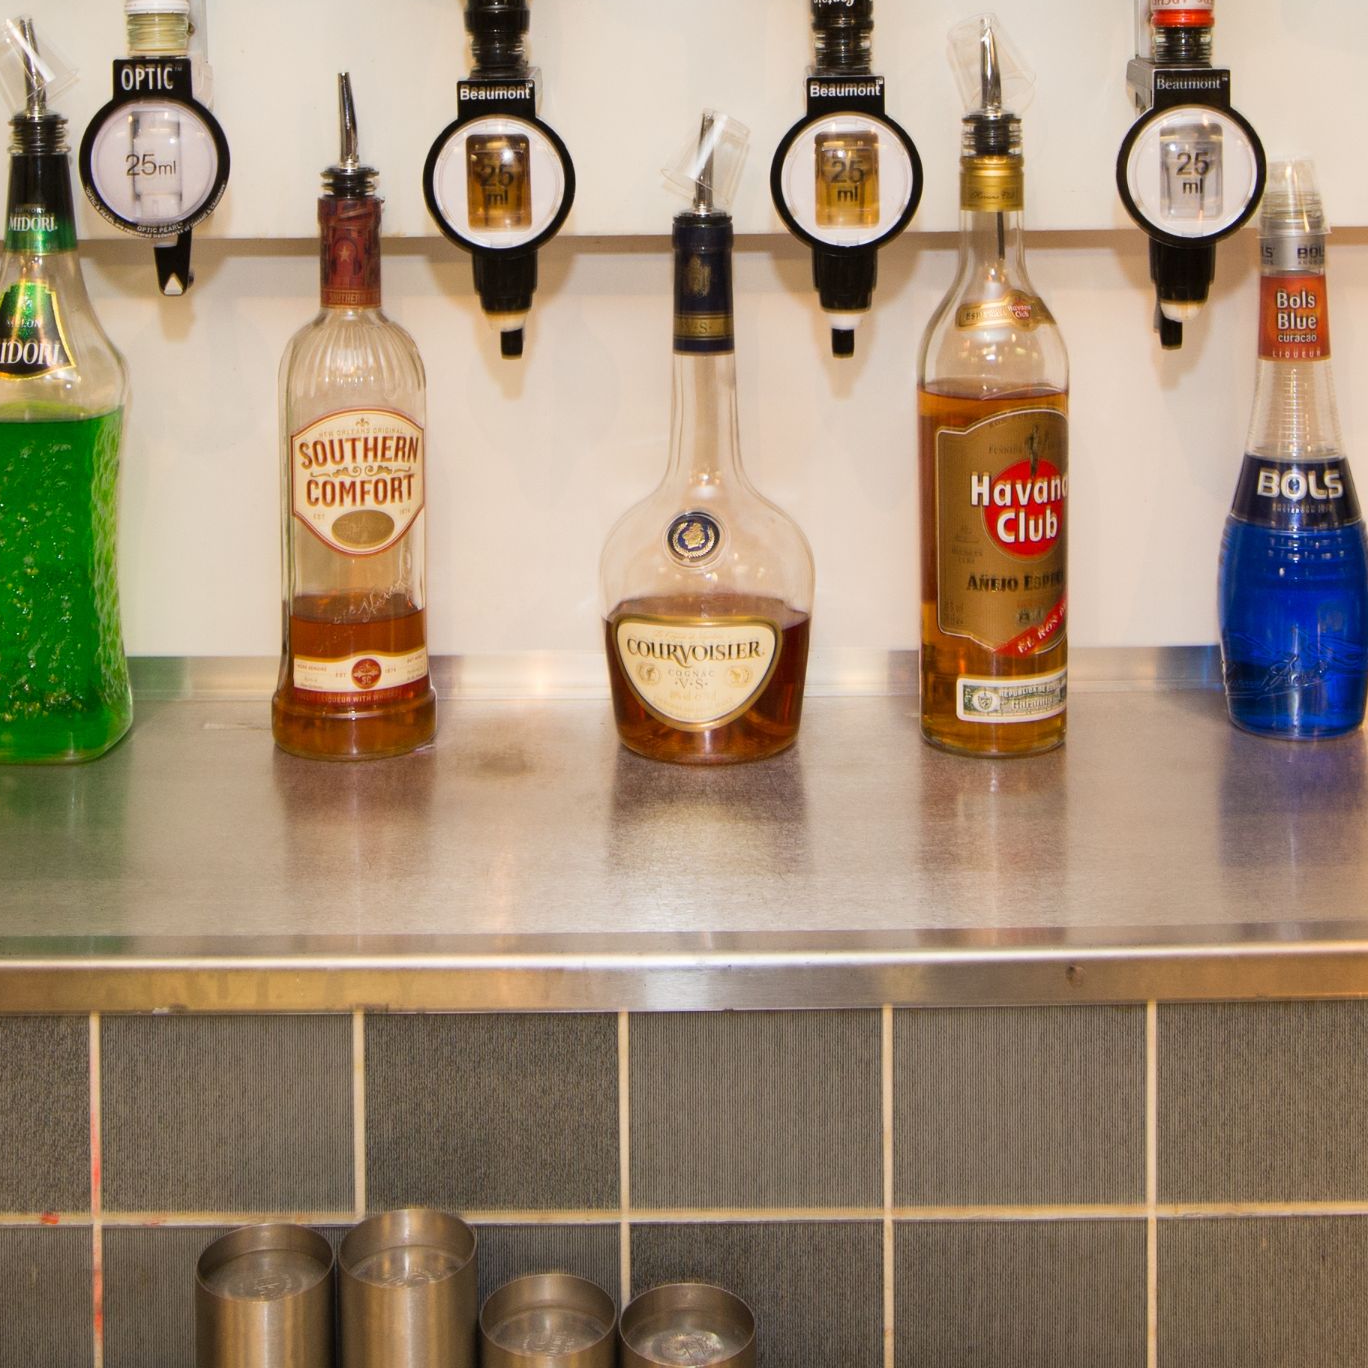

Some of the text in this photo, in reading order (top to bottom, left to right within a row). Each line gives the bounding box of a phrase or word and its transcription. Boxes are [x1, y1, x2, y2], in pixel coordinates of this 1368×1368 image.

[120, 67, 174, 91] OPTIC
[1155, 78, 1221, 91] Beaumont
[459, 87, 531, 102] Beaumont
[809, 83, 881, 98] Beaumont
[831, 159, 864, 184] 25
[1175, 151, 1210, 177] 25
[479, 163, 514, 188] 25
[836, 185, 859, 203] ml
[1182, 177, 1204, 195] ml
[487, 188, 509, 206] ml
[8, 215, 56, 232] MIDORI
[1276, 289, 1316, 309] Bols
[1277, 311, 1317, 330] Blue
[1272, 349, 1321, 359] LIQUEUR
[298, 435, 420, 470] SOUTHERN
[306, 474, 415, 508] COMFORT
[970, 470, 1069, 508] Havana
[1256, 469, 1344, 500] BOLS
[996, 508, 1059, 544] Club
[626, 638, 762, 669] COURVOISIER
[667, 669, 716, 678] COGNAC
